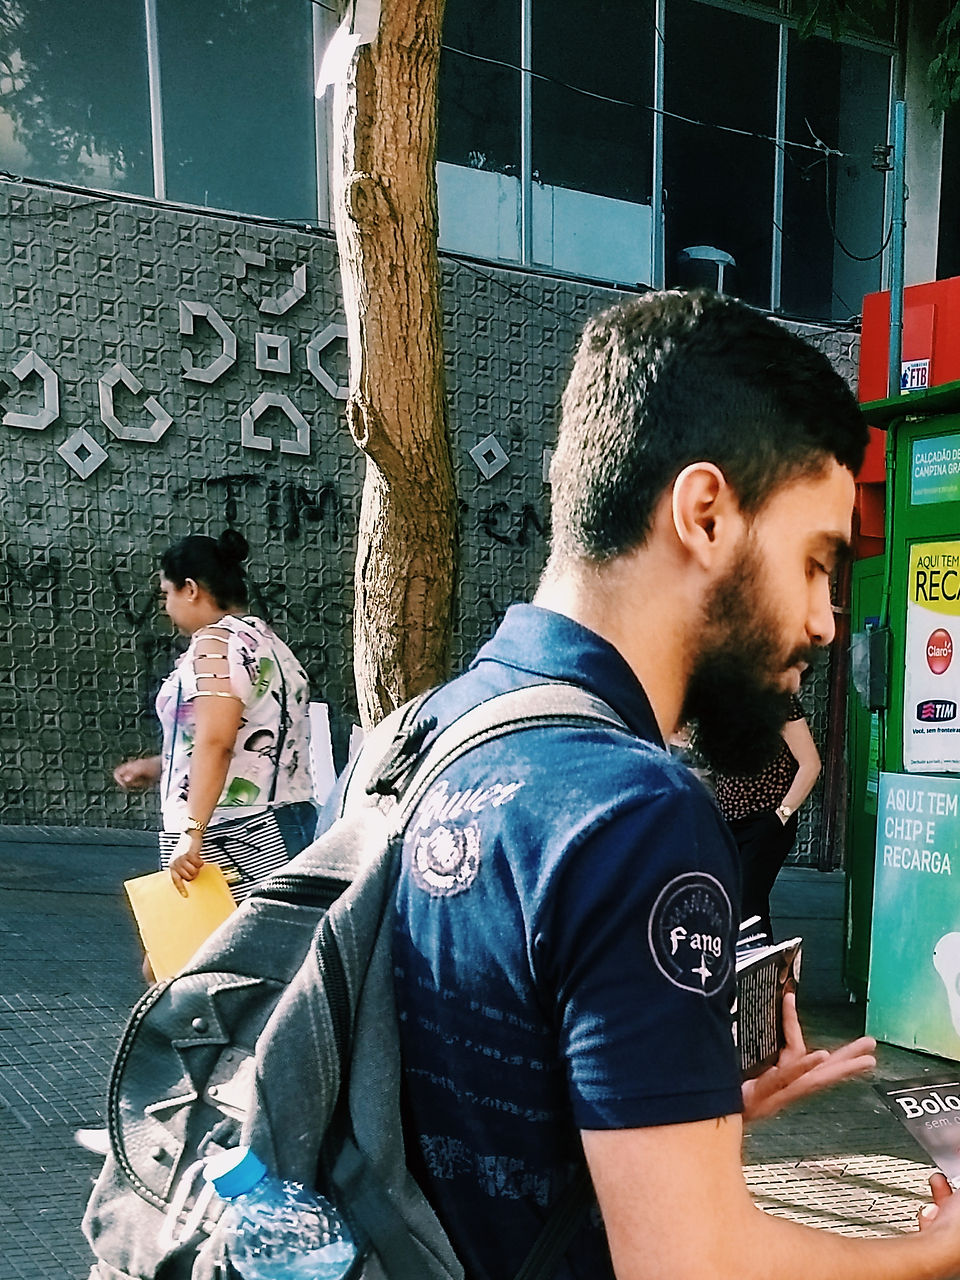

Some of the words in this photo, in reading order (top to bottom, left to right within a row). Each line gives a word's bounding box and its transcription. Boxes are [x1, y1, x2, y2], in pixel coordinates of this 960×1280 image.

[910, 367, 927, 387] FTB
[915, 448, 951, 464] CALÇADÃO
[914, 463, 948, 478] CAMPINA
[917, 555, 940, 570] AQUI
[941, 554, 960, 568] TEM
[927, 643, 950, 657] Claro
[935, 703, 955, 719] TIM
[886, 788, 924, 814] AQUI
[928, 793, 958, 817] TEM
[884, 817, 922, 843] CHIP
[925, 821, 936, 844] E
[883, 845, 952, 875] RECARGA
[925, 1117, 951, 1130] sem
